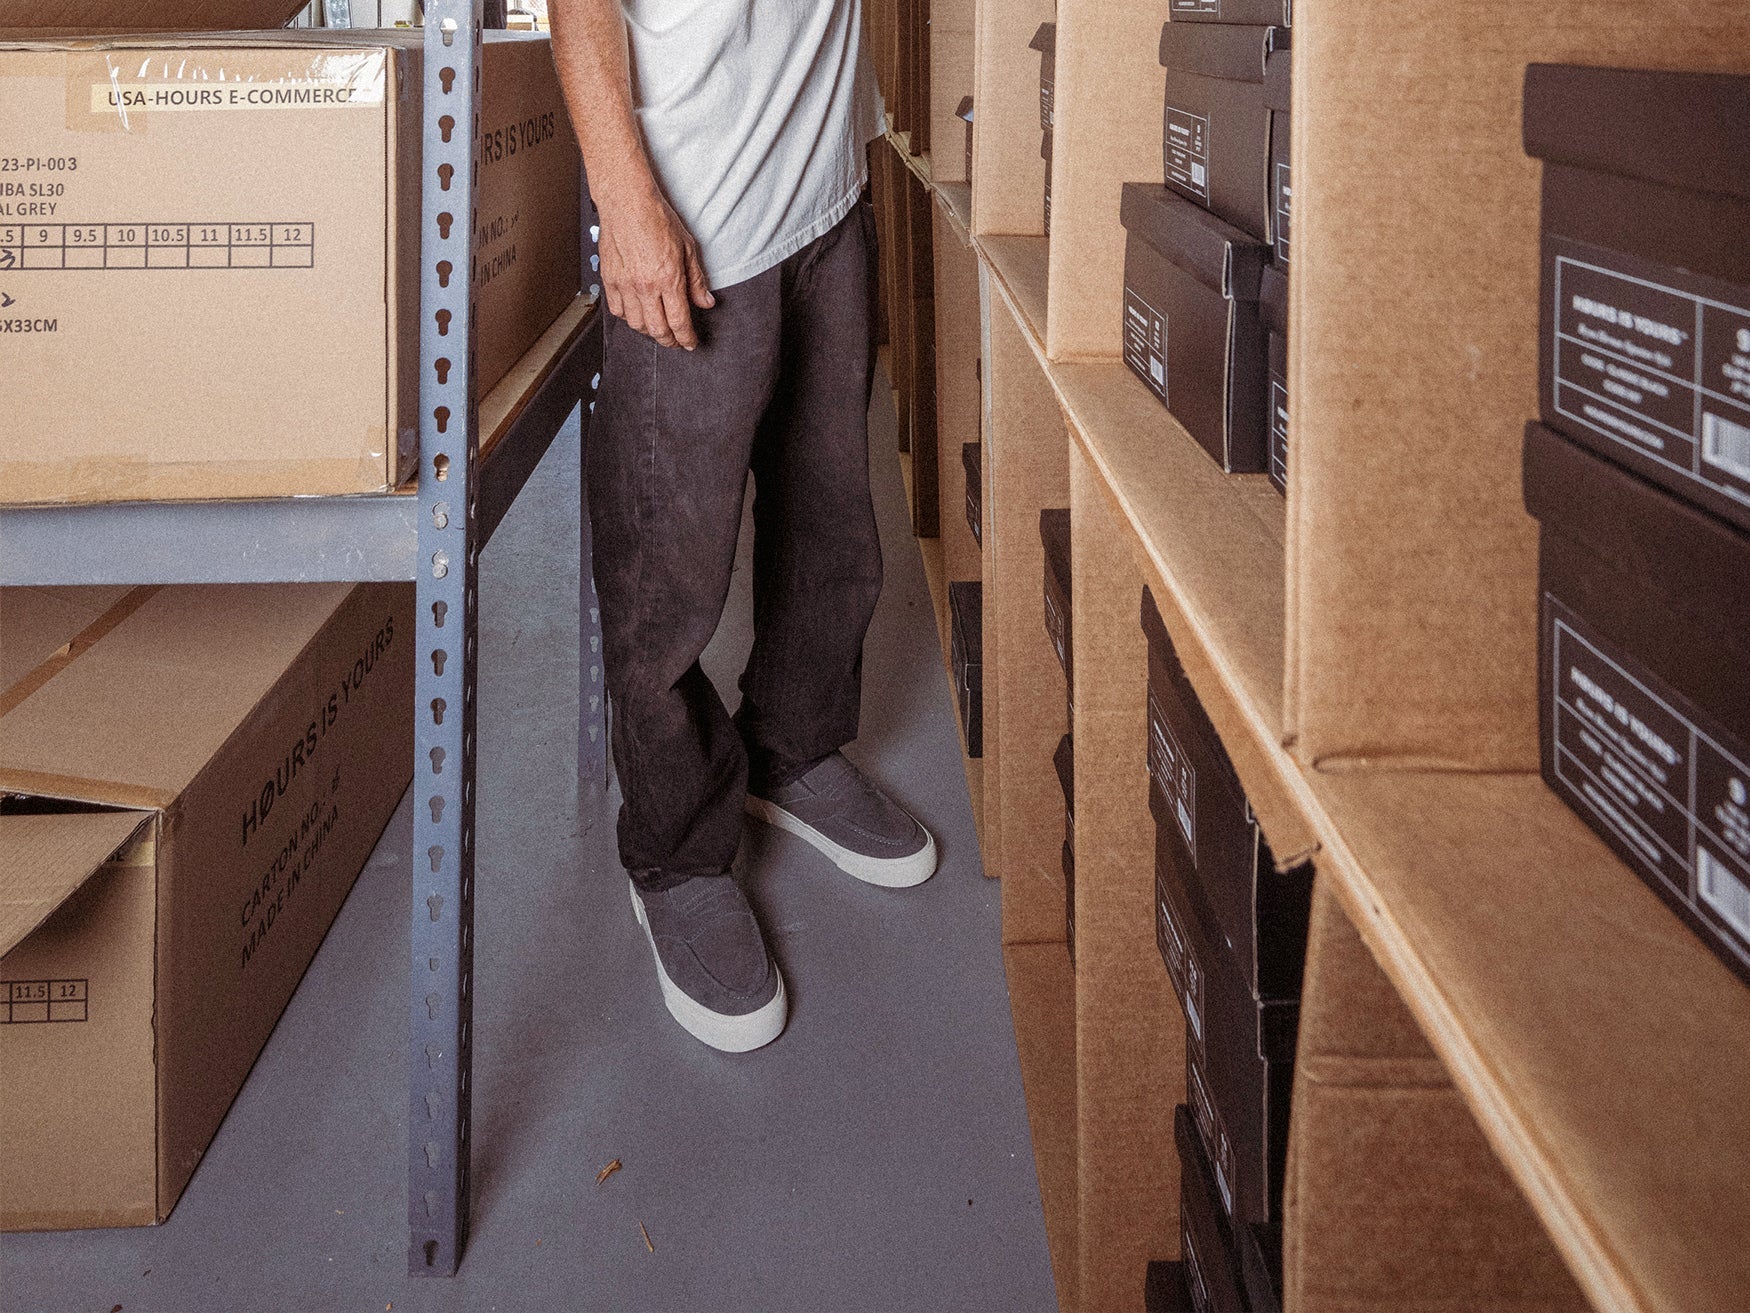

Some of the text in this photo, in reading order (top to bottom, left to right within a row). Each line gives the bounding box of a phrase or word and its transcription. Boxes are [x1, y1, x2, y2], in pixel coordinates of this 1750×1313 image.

[505, 124, 517, 157] IS
[519, 111, 554, 151] YOURS
[29, 182, 65, 197] SL30
[16, 202, 57, 216] GREY
[39, 229, 48, 243] 9
[73, 229, 97, 243] 9.5
[118, 228, 136, 242] 10
[153, 228, 185, 242] 10.5
[201, 228, 219, 242] 11
[235, 228, 268, 242] 11.5
[284, 228, 302, 242] 12
[492, 244, 517, 278] CHINA
[322, 693, 339, 737] IS
[342, 615, 394, 703] YOURS
[242, 829, 298, 928] CARTON
[242, 804, 338, 969] MADE IN CHINA
[16, 984, 76, 998] 11.5 12
